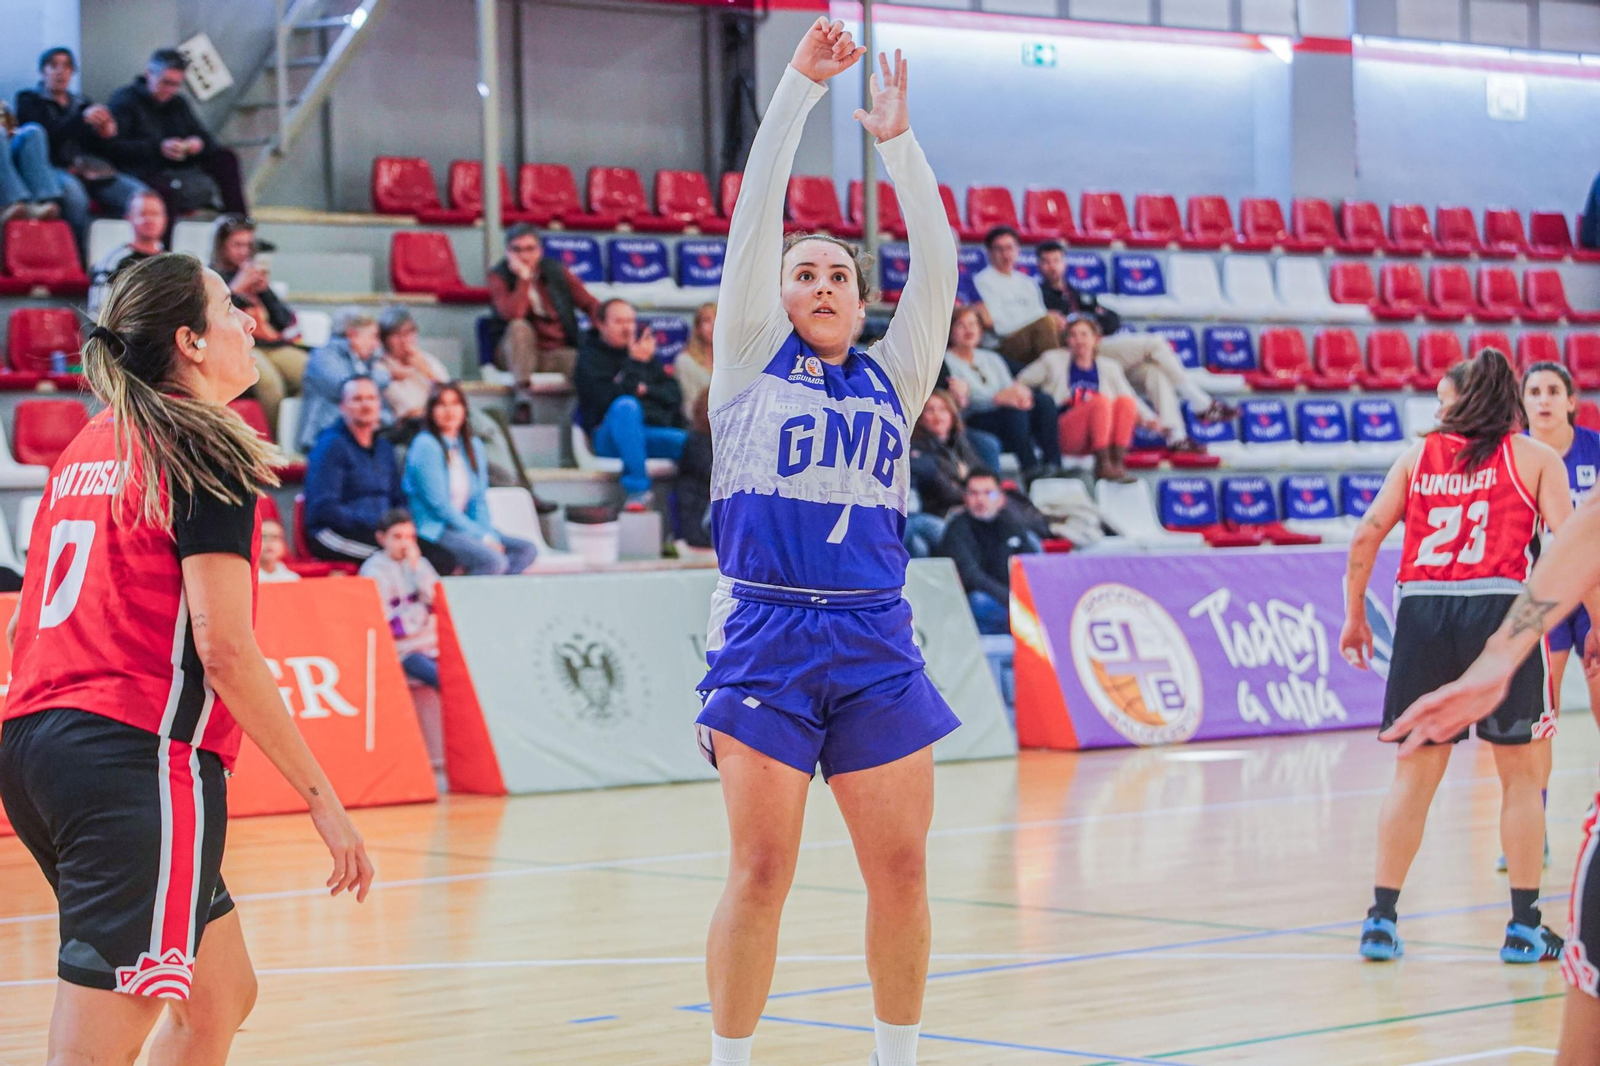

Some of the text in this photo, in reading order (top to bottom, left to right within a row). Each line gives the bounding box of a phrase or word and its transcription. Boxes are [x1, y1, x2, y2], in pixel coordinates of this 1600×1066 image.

[777, 407, 904, 488] GMB
[826, 491, 853, 544] 7
[1413, 500, 1489, 567] 23
